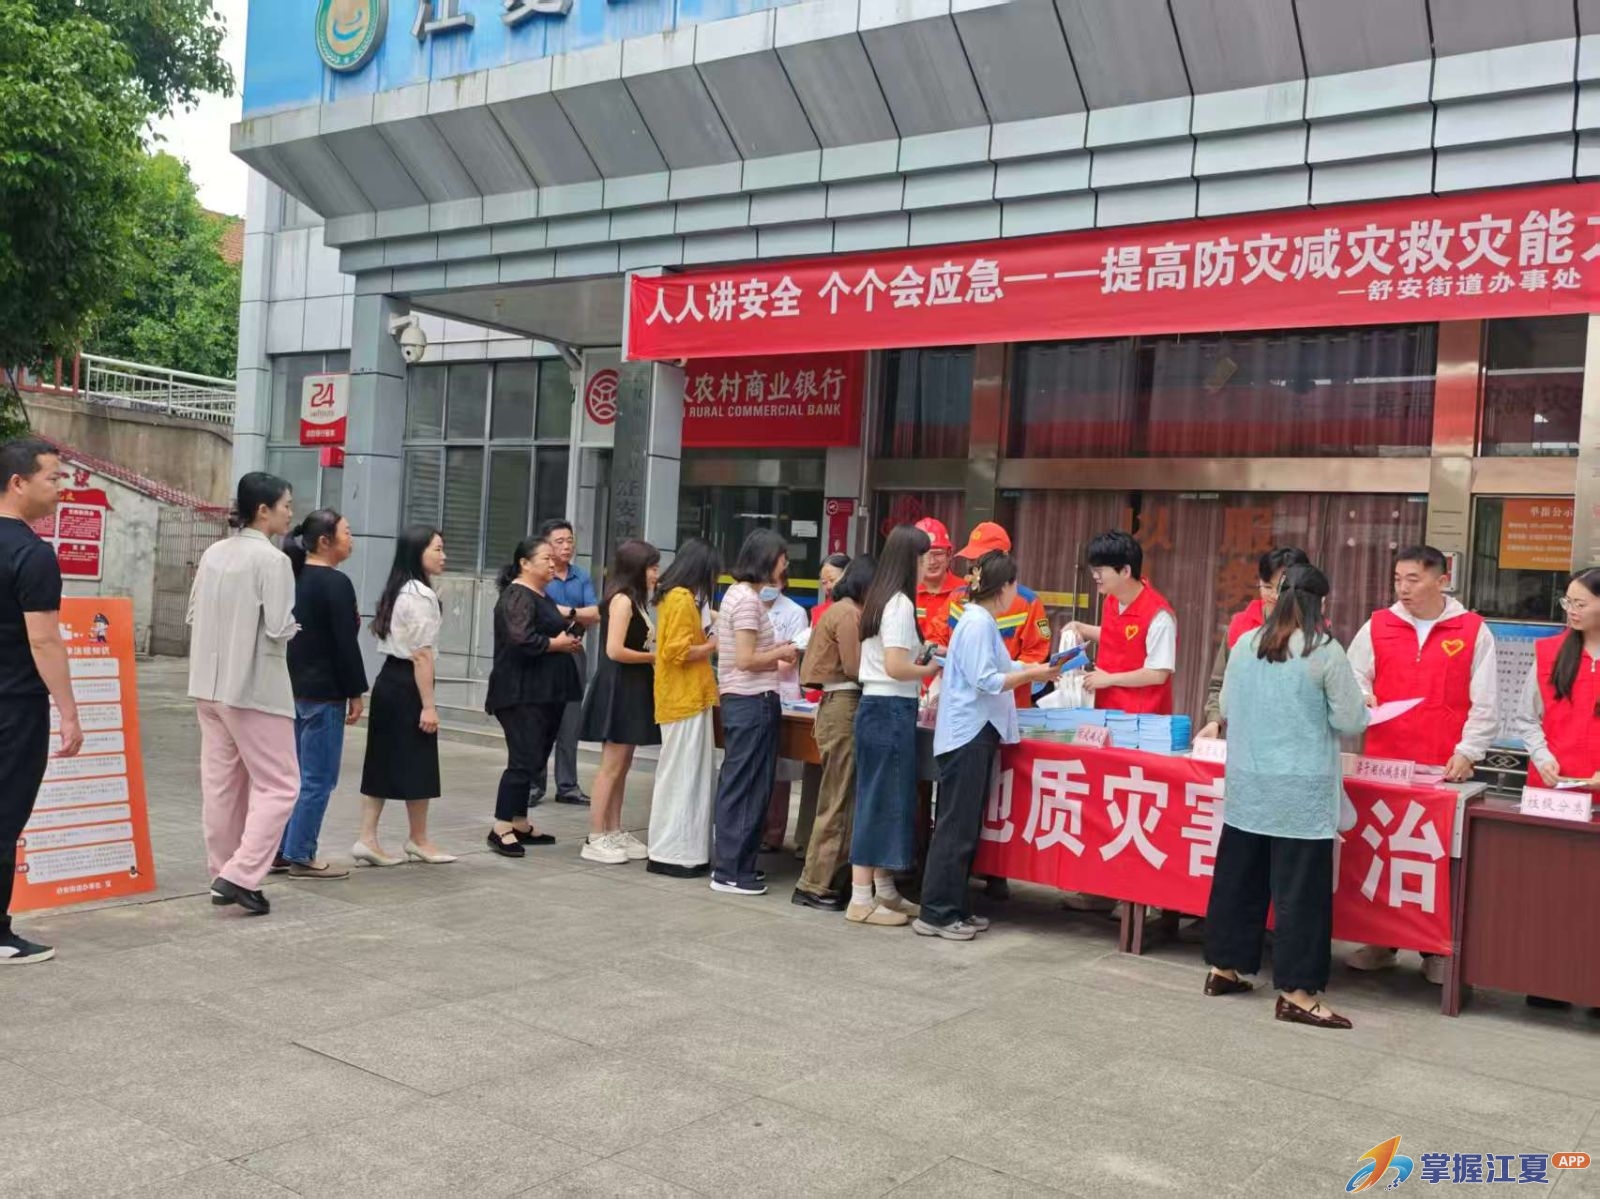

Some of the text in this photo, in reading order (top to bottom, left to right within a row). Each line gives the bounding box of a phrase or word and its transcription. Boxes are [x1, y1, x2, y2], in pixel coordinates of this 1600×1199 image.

[645, 276, 802, 326] 人人讲安全
[310, 383, 335, 408] 24
[689, 403, 841, 418] RURAL COMMERCIAL BANK
[981, 751, 1446, 914] 质灾害治
